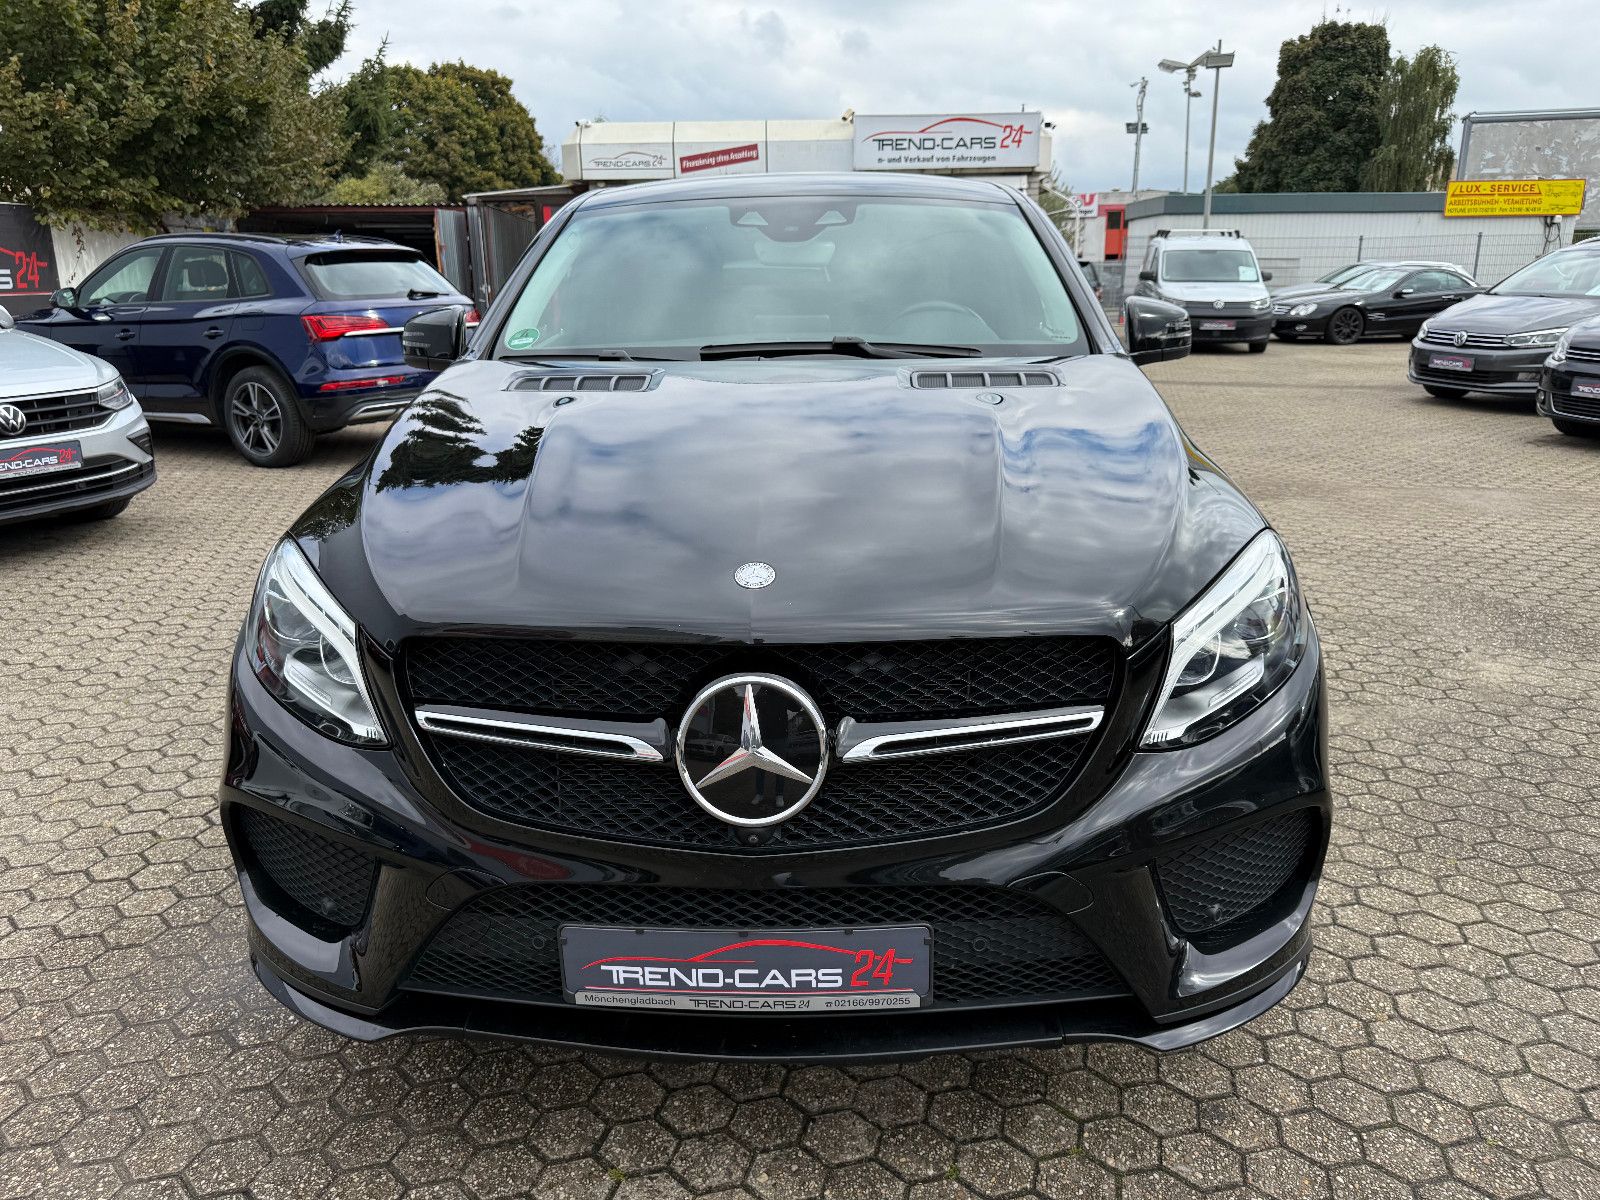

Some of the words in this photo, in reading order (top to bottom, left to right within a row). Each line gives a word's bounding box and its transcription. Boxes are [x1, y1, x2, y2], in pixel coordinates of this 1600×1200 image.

[872, 136, 996, 151] TREND-CARS
[1000, 124, 1033, 149] 24
[904, 155, 934, 163] Verkauf
[952, 155, 996, 164] Fahrzeugen
[1459, 184, 1481, 193] LUX
[1489, 183, 1536, 193] SERVICE
[1503, 197, 1543, 206] VERMIETUNG
[15, 250, 48, 289] 24
[59, 447, 77, 463] 24
[600, 964, 843, 989] TREND-CARS
[850, 947, 913, 988] 24
[584, 994, 676, 1006] Mönchengladbach
[689, 998, 796, 1010] TREND-CARS
[799, 1000, 811, 1009] 24
